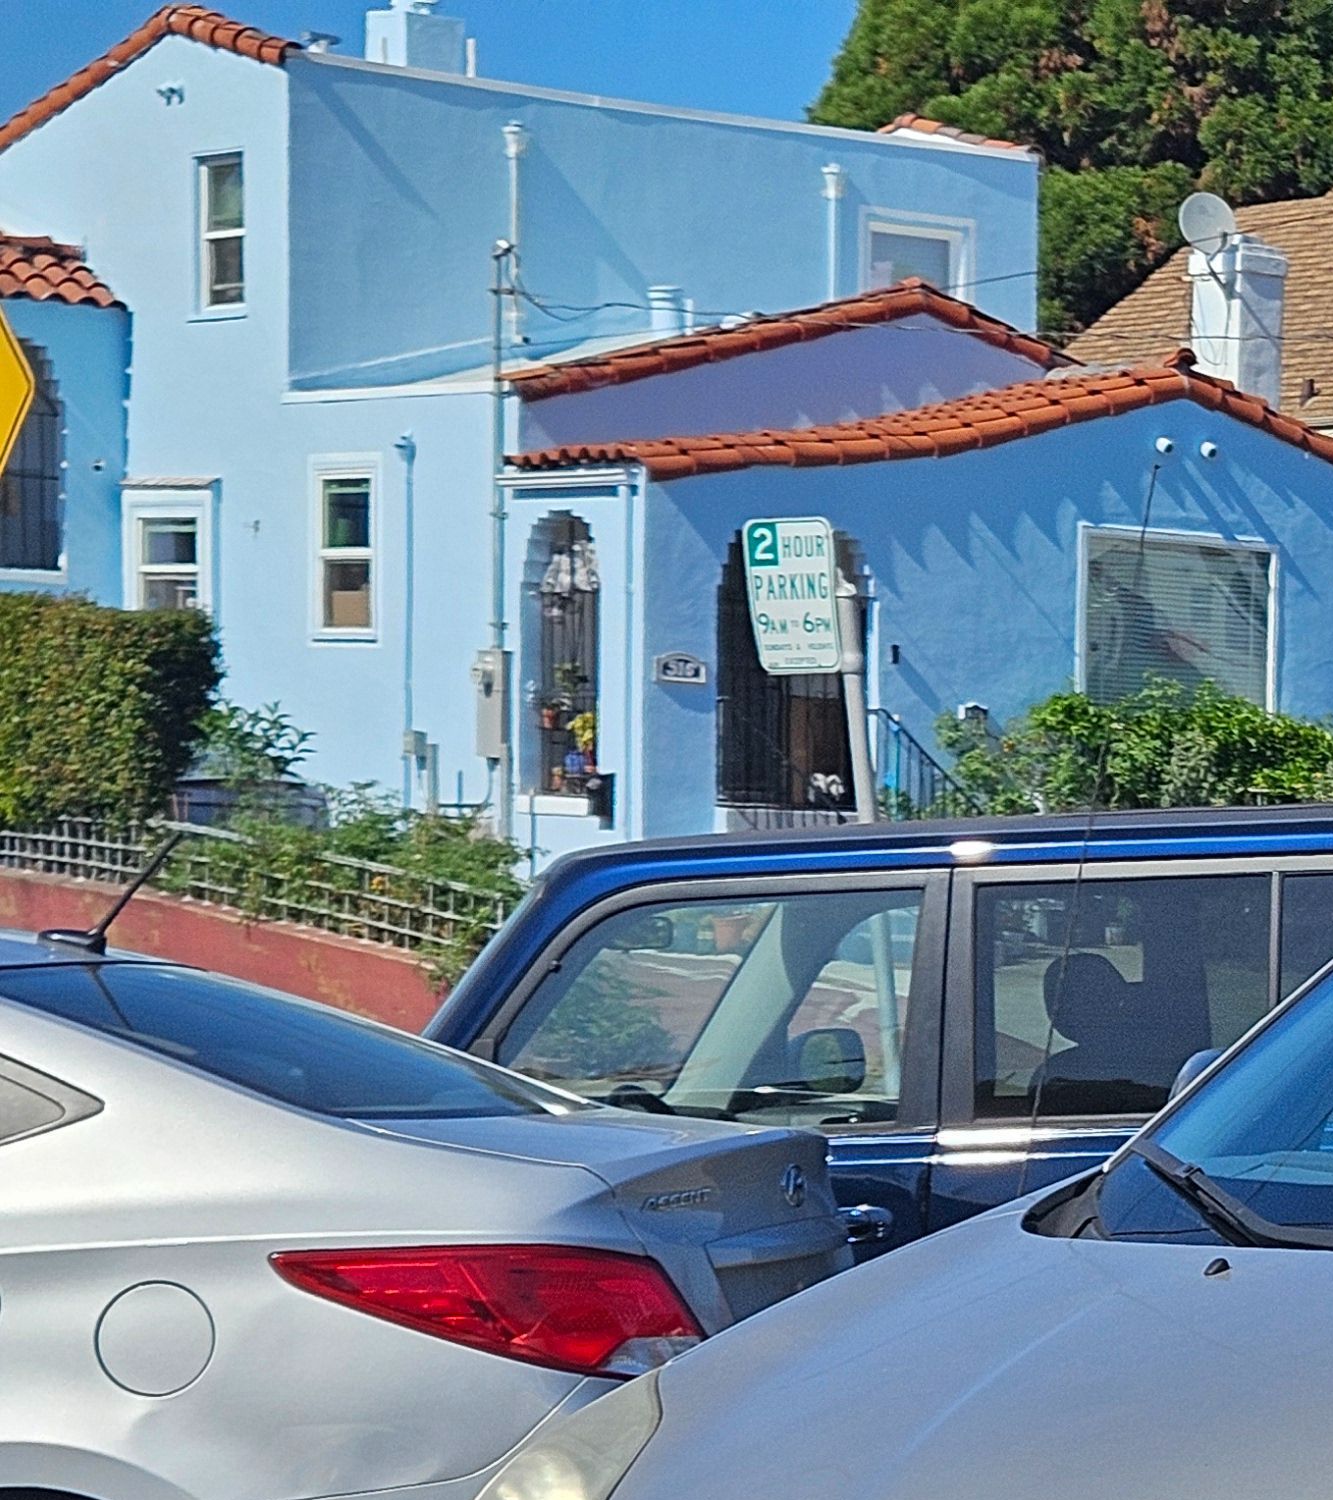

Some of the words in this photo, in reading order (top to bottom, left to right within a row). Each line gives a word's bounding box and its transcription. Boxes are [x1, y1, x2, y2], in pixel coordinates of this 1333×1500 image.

[753, 527, 775, 560] 2
[781, 534, 825, 558] HOUR
[754, 571, 828, 601] PARKING
[757, 612, 788, 634] 9AM
[803, 611, 832, 633] 6PM
